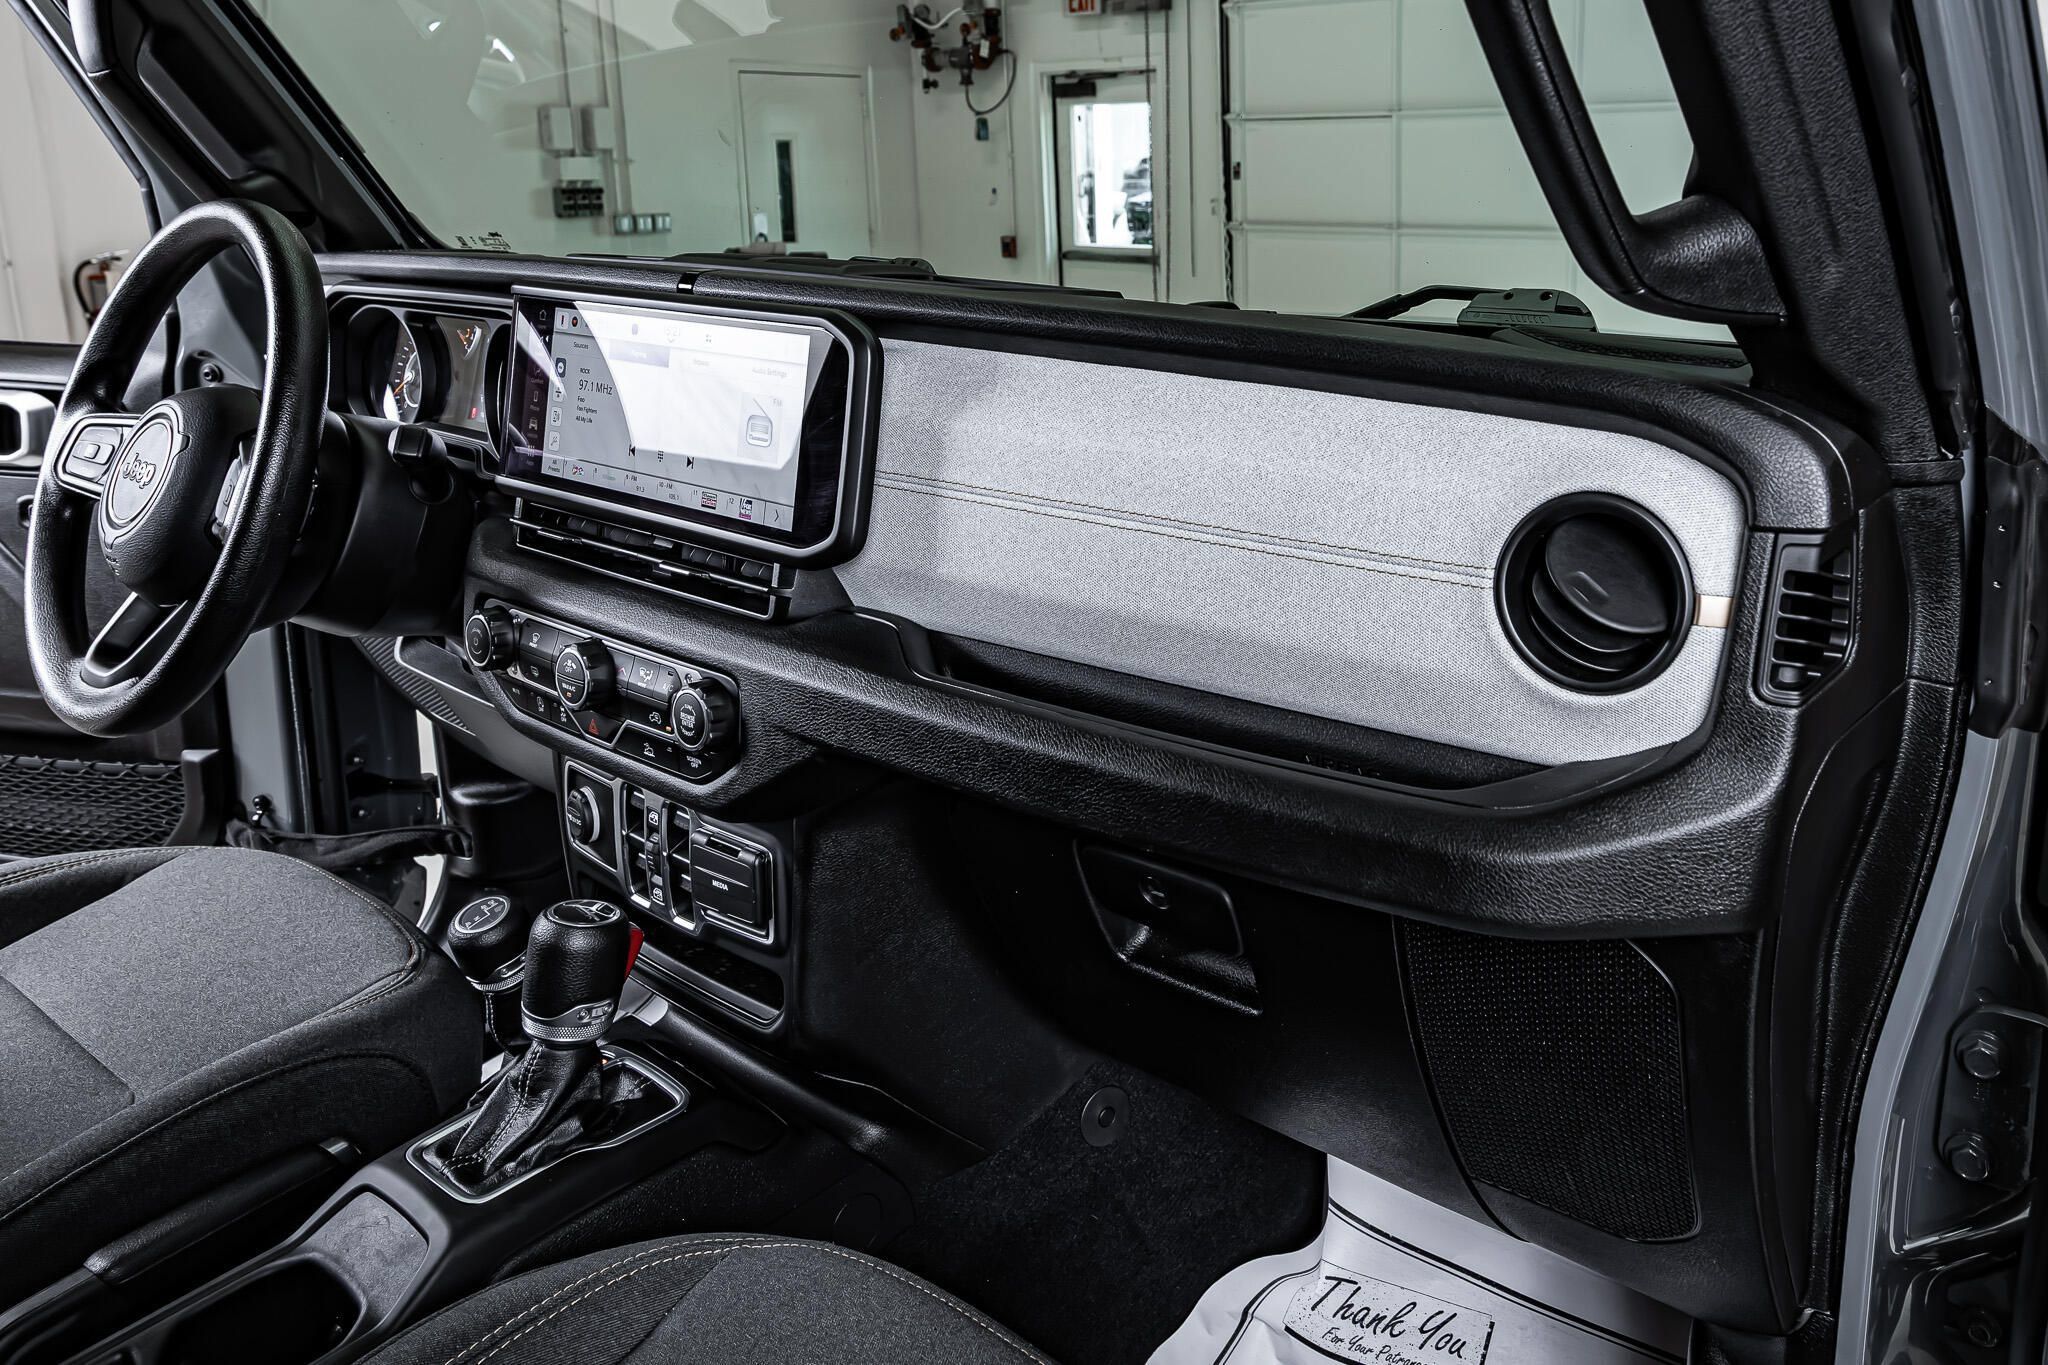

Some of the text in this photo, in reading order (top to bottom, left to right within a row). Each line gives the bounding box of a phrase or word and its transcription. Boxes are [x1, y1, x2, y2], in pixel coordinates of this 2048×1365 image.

[573, 341, 589, 350] Sources
[578, 379, 613, 396] 97.1 MHz
[122, 452, 157, 490] Jeep
[686, 755, 702, 765] SCREEN
[712, 879, 729, 891] MEDIA
[1310, 1275, 1468, 1360] Thank You
[1321, 1326, 1346, 1344] For
[1348, 1335, 1375, 1356] Your
